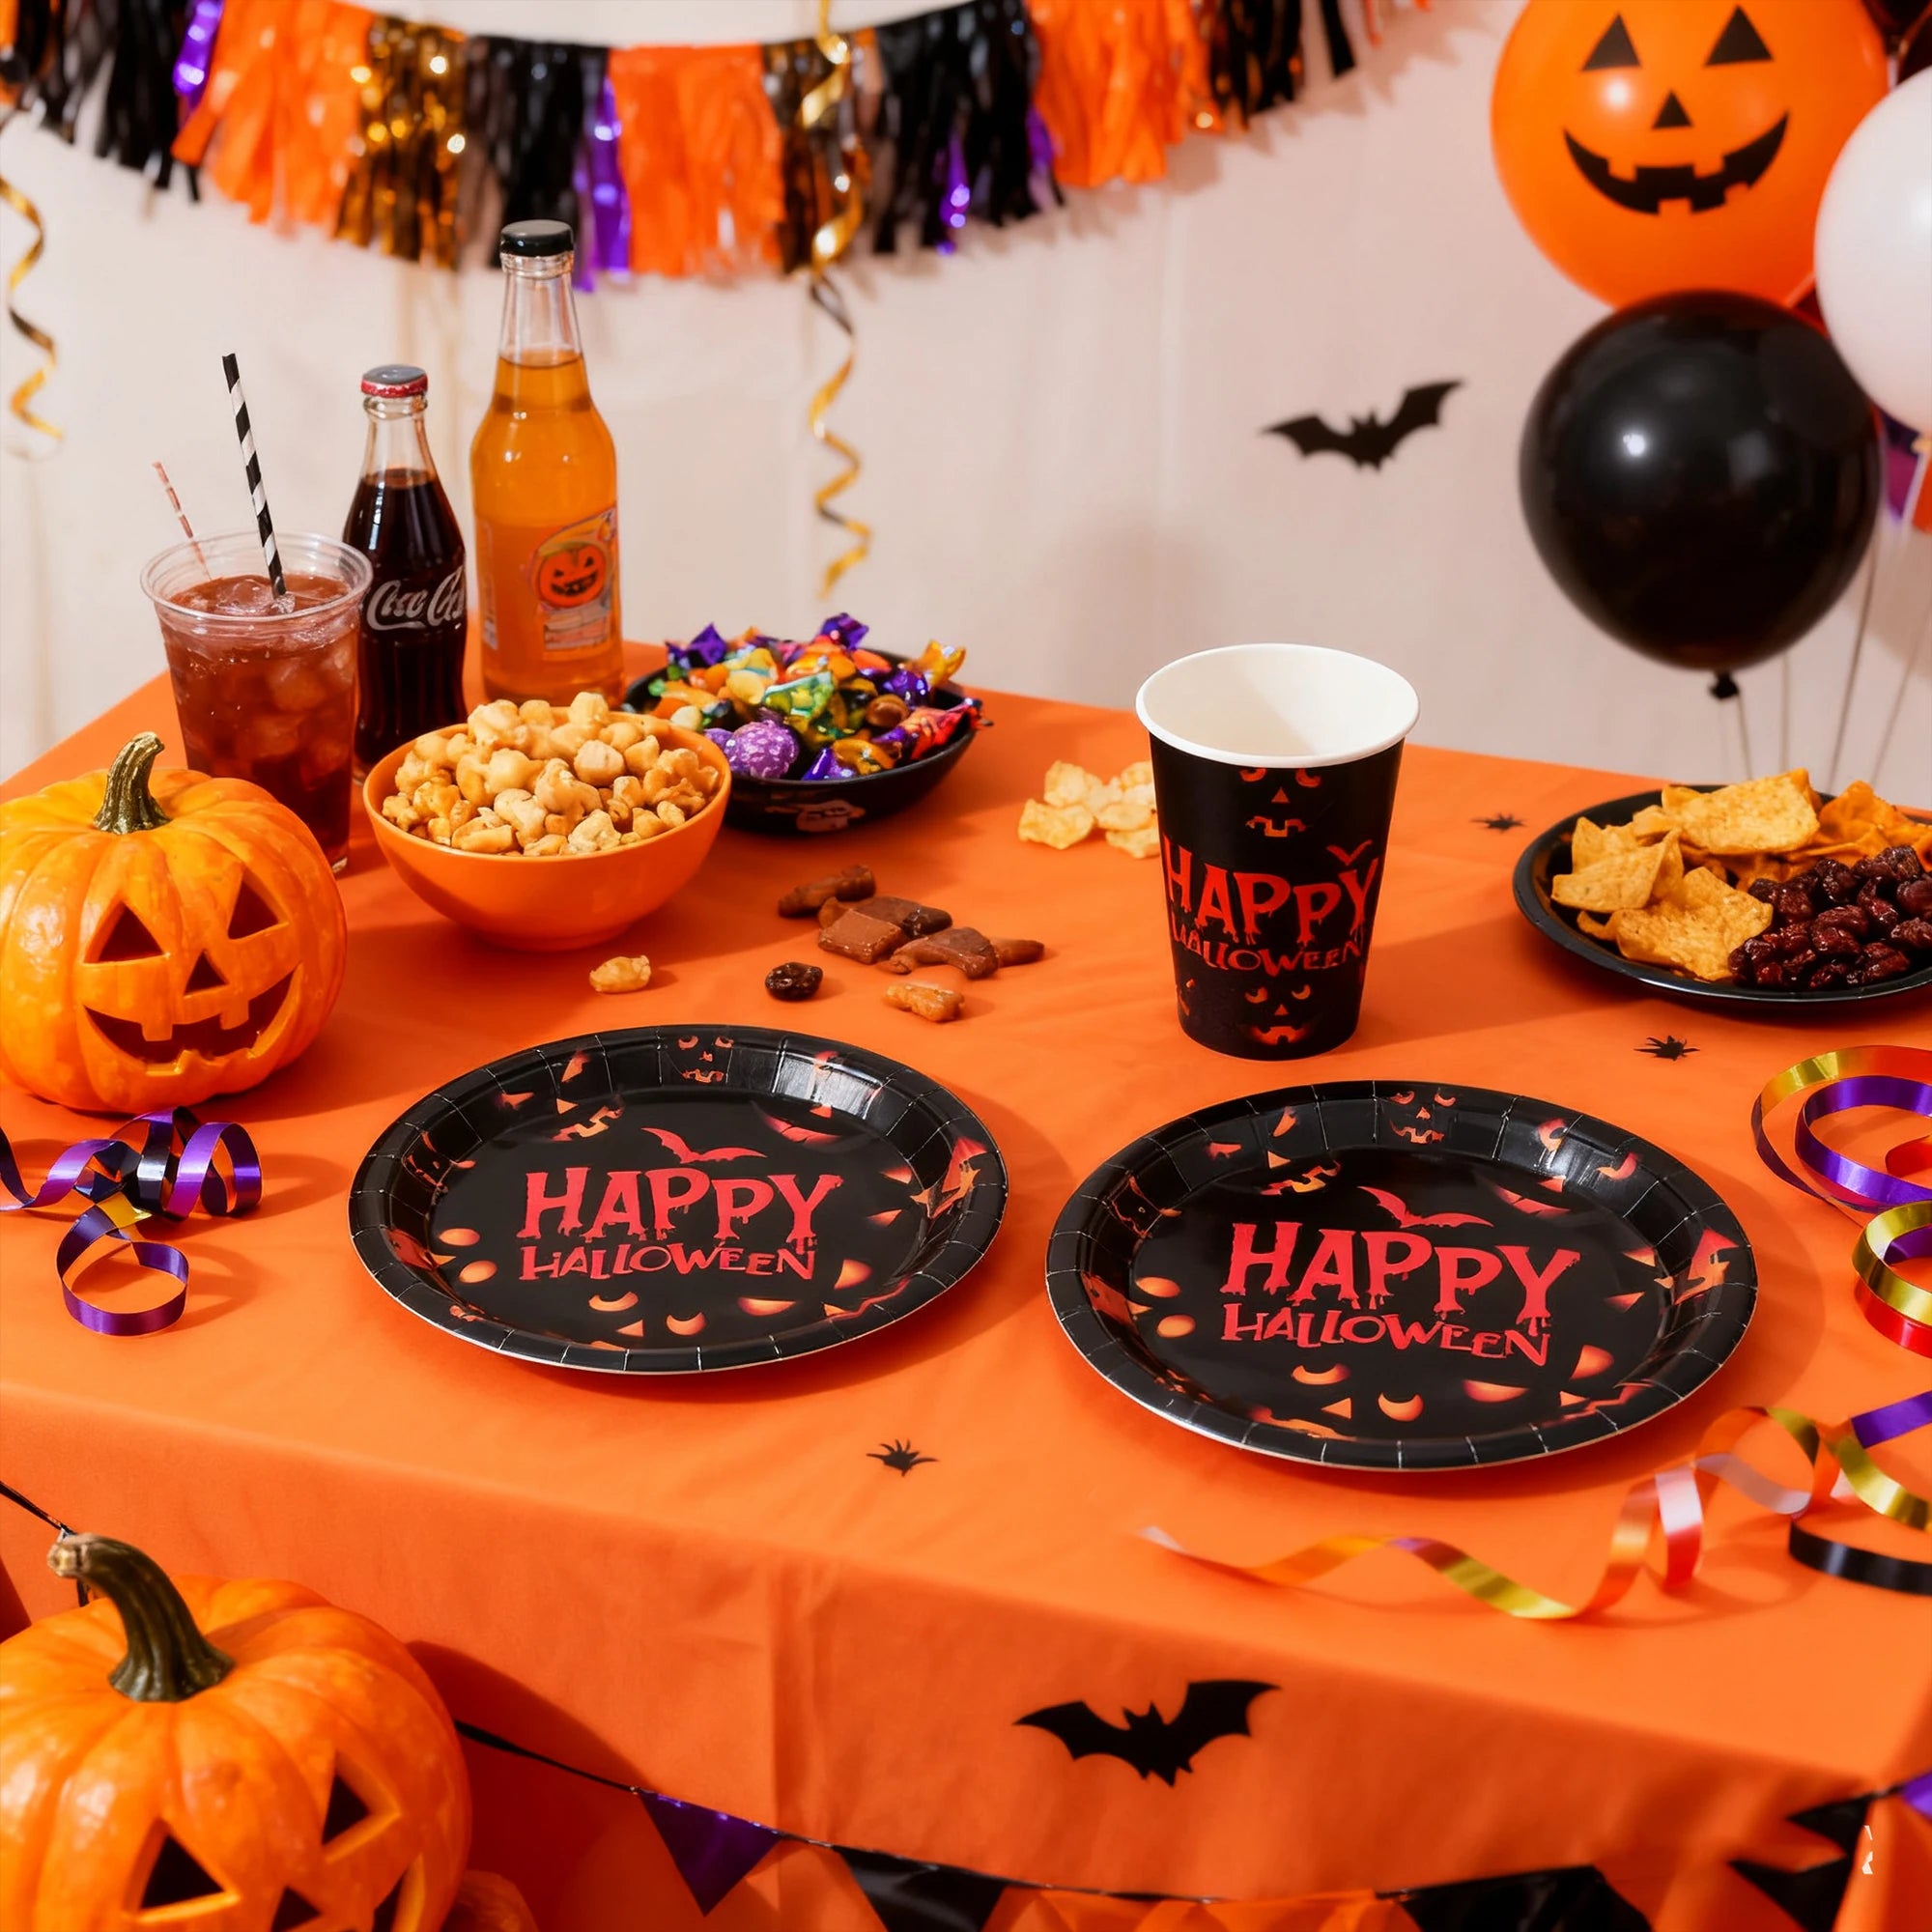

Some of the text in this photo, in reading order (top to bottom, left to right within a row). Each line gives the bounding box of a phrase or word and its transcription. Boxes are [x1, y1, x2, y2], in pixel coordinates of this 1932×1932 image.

[1163, 835, 1379, 945] HAPPY
[516, 1167, 844, 1254] HAPPY
[519, 1243, 816, 1280] HALLOWEEN
[1220, 1221, 1580, 1337] HAPPY
[1221, 1303, 1550, 1366] HALLOWEEN
